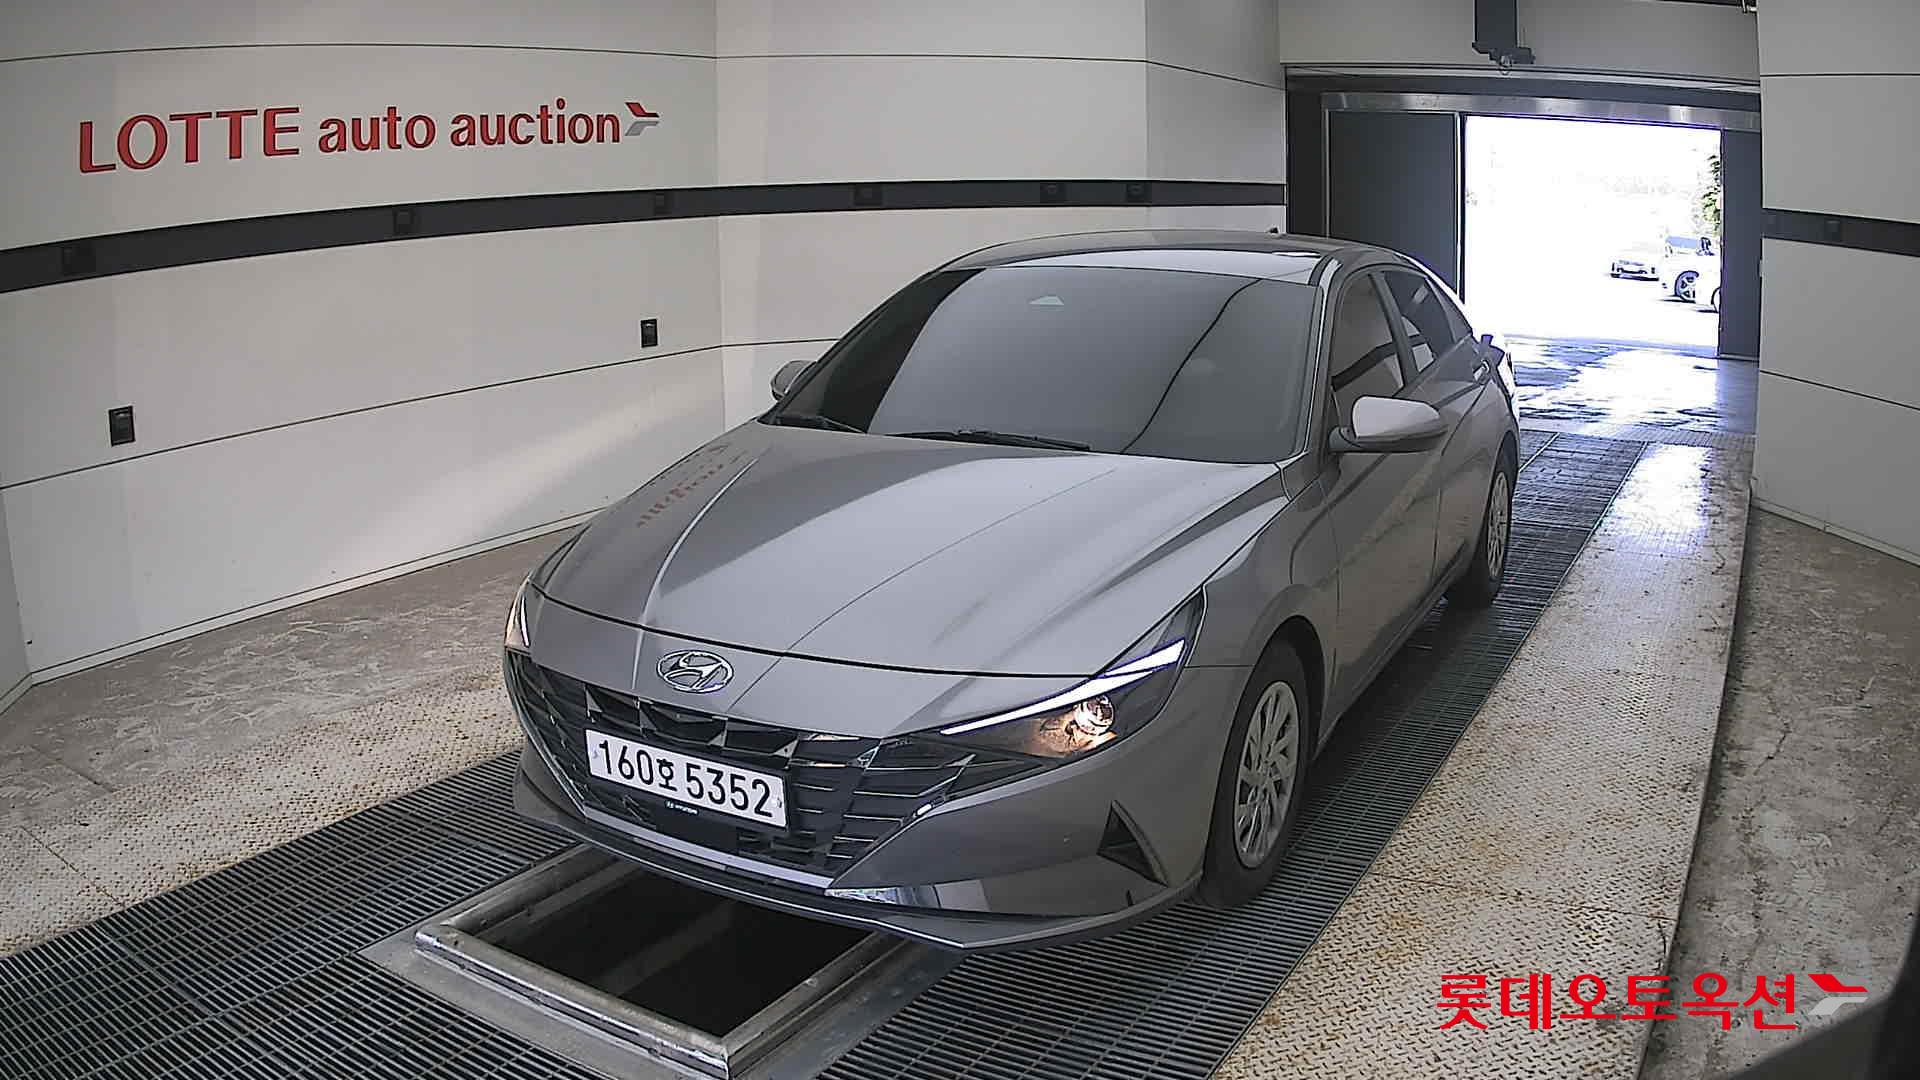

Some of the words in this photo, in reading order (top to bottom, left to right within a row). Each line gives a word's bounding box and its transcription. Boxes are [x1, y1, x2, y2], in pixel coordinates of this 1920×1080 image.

[80, 107, 300, 173] LOTTE
[317, 106, 436, 153] auto
[450, 98, 622, 147] auction
[686, 762, 773, 817] 5352
